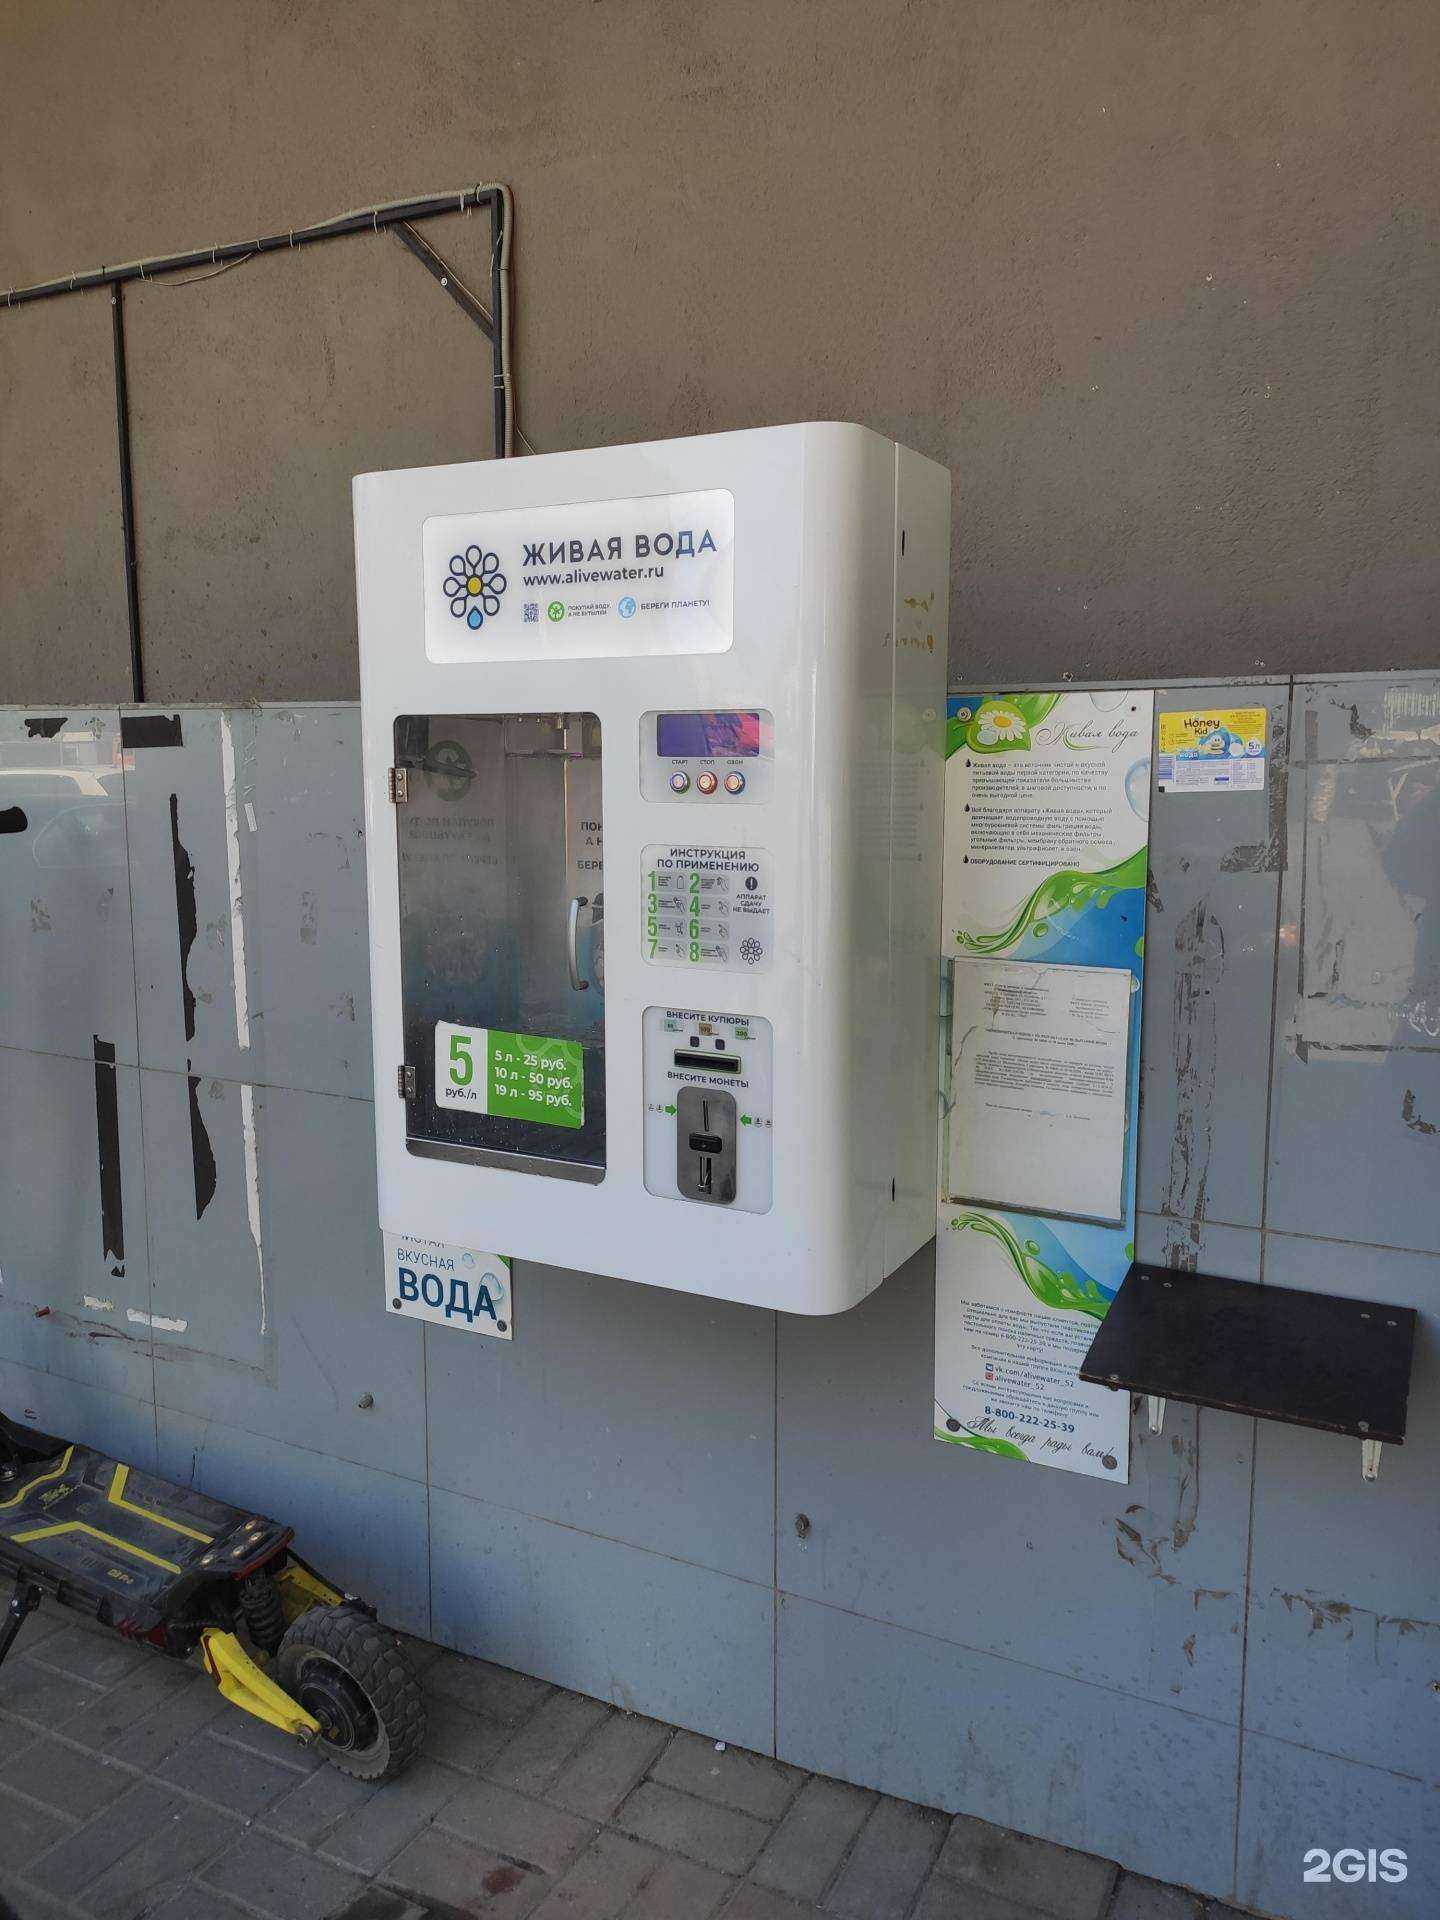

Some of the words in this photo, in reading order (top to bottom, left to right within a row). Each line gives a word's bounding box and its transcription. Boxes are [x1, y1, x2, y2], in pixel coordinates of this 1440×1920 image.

[522, 536, 622, 567] ЖИВАЯ
[634, 529, 718, 559] ВОДА
[523, 565, 664, 586] www.alivewater.ru
[640, 602, 670, 610] БЕРЕГИ
[1184, 718, 1220, 730] Honey
[1108, 720, 1138, 753] вода
[670, 848, 746, 860] ИНСТРУКЦИЯ
[657, 859, 672, 868] ПО
[676, 860, 759, 872] ПРИМЕНЕНИЮ
[648, 871, 656, 892] 1
[690, 873, 700, 894] 2
[648, 893, 657, 914] 3
[690, 896, 700, 916] 4
[648, 916, 657, 936] 5
[689, 919, 699, 939] 6
[648, 939, 658, 959] 7
[689, 942, 699, 961] 8
[666, 1010, 706, 1022] ВНЕСИТЕ
[708, 1014, 749, 1026] КУПЮРЫ
[449, 1034, 473, 1086] 5
[495, 1050, 502, 1061] 5
[504, 1053, 513, 1062] л
[523, 1054, 538, 1066] 25
[540, 1058, 566, 1071] руб.
[495, 1066, 508, 1079] 10
[510, 1071, 518, 1080] л
[529, 1072, 544, 1084] 50
[547, 1076, 573, 1090] руб.
[667, 1071, 707, 1084] ВНЕСИТЕ
[709, 1077, 749, 1088] МОНЕТЫ
[445, 1087, 477, 1100] руб./л
[494, 1084, 507, 1096] 19
[509, 1088, 518, 1098] л
[528, 1090, 543, 1101] 95
[546, 1094, 572, 1107] руб.
[397, 1248, 455, 1271] ВКУСНАЯ
[398, 1267, 497, 1323] ВОДА
[984, 1406, 1075, 1433] 8-800-222-25-39
[1005, 1426, 1036, 1446] всегда
[1040, 1437, 1072, 1454] рады
